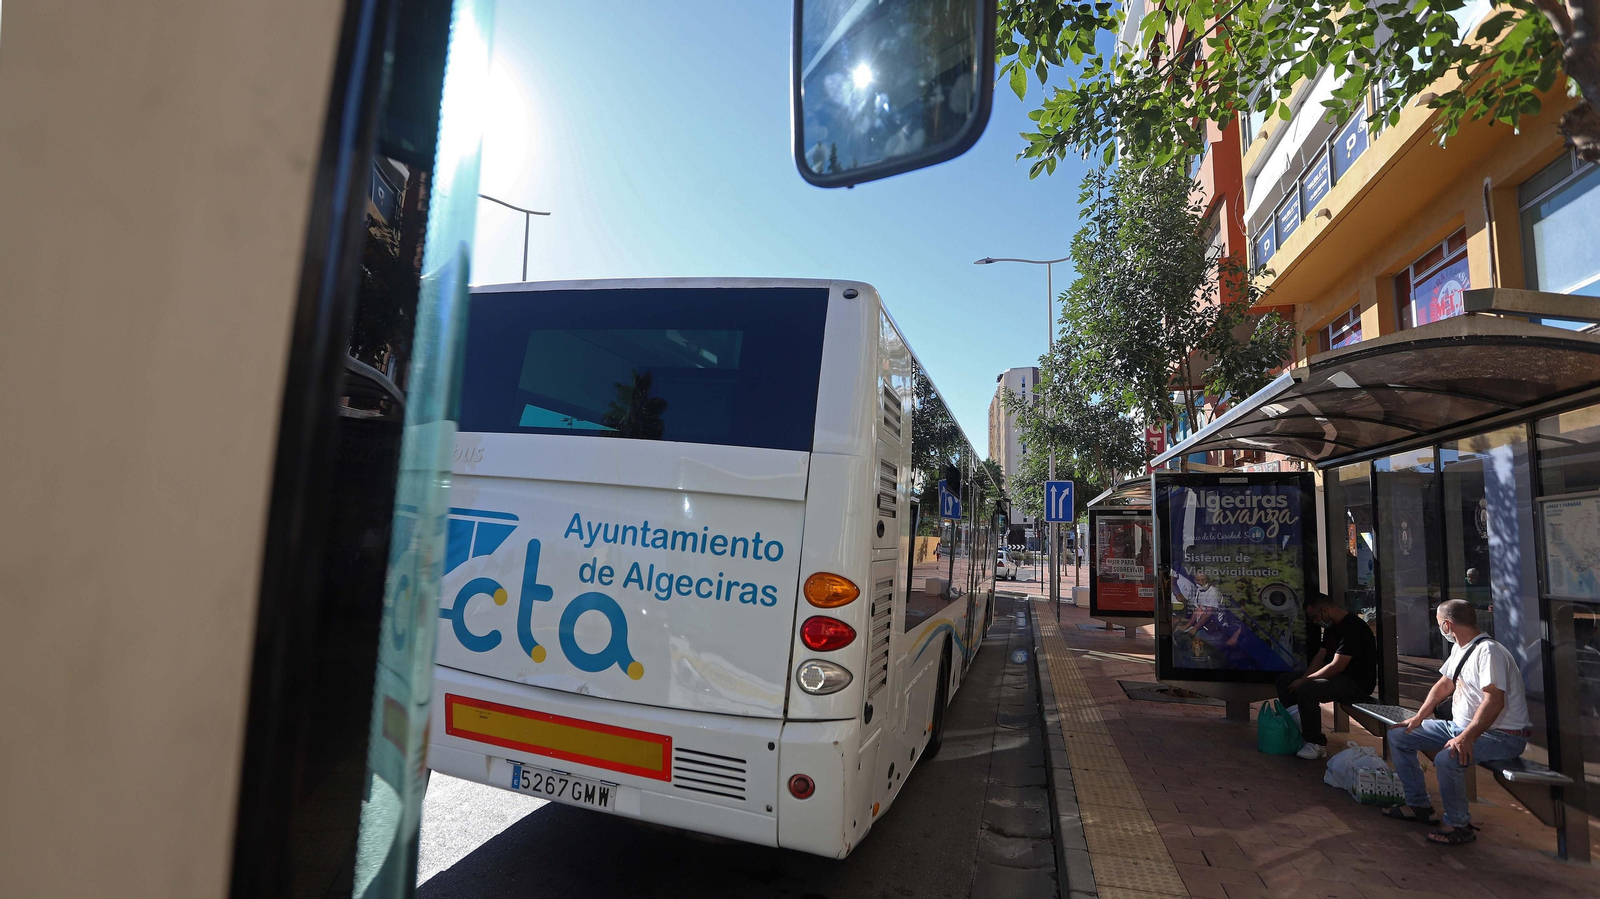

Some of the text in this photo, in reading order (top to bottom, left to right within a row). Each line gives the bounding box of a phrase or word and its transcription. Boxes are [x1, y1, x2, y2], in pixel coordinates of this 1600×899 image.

[1183, 489, 1288, 513] Algeciras
[563, 512, 785, 562] Ayuntamiento
[1212, 508, 1299, 538] avanza
[1184, 553, 1251, 563] Sistema de
[1184, 566, 1279, 578] Videovigilancia
[578, 556, 778, 607] de Algeciras
[521, 769, 569, 798] 5267
[571, 781, 610, 808] GMW
